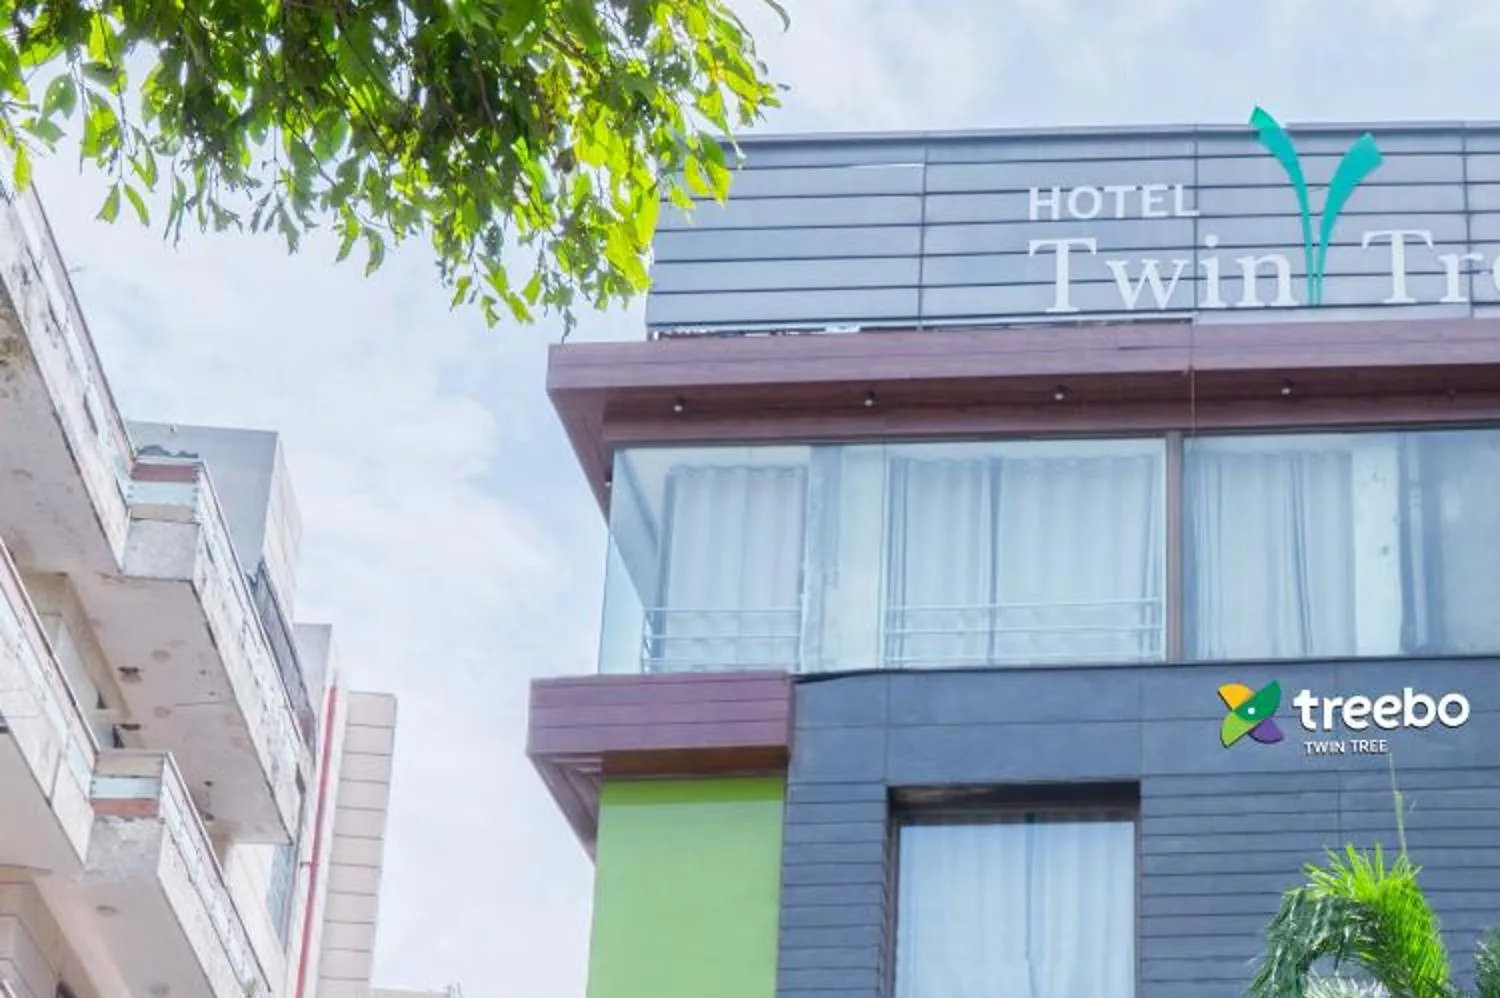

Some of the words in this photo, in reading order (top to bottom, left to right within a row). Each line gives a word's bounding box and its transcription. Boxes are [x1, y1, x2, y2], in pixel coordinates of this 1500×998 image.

[1028, 183, 1200, 221] HOTEL
[1028, 233, 1293, 313] Twin
[1292, 687, 1470, 730] treebo
[1304, 740, 1345, 754] TWIN
[1350, 739, 1389, 753] TREE
